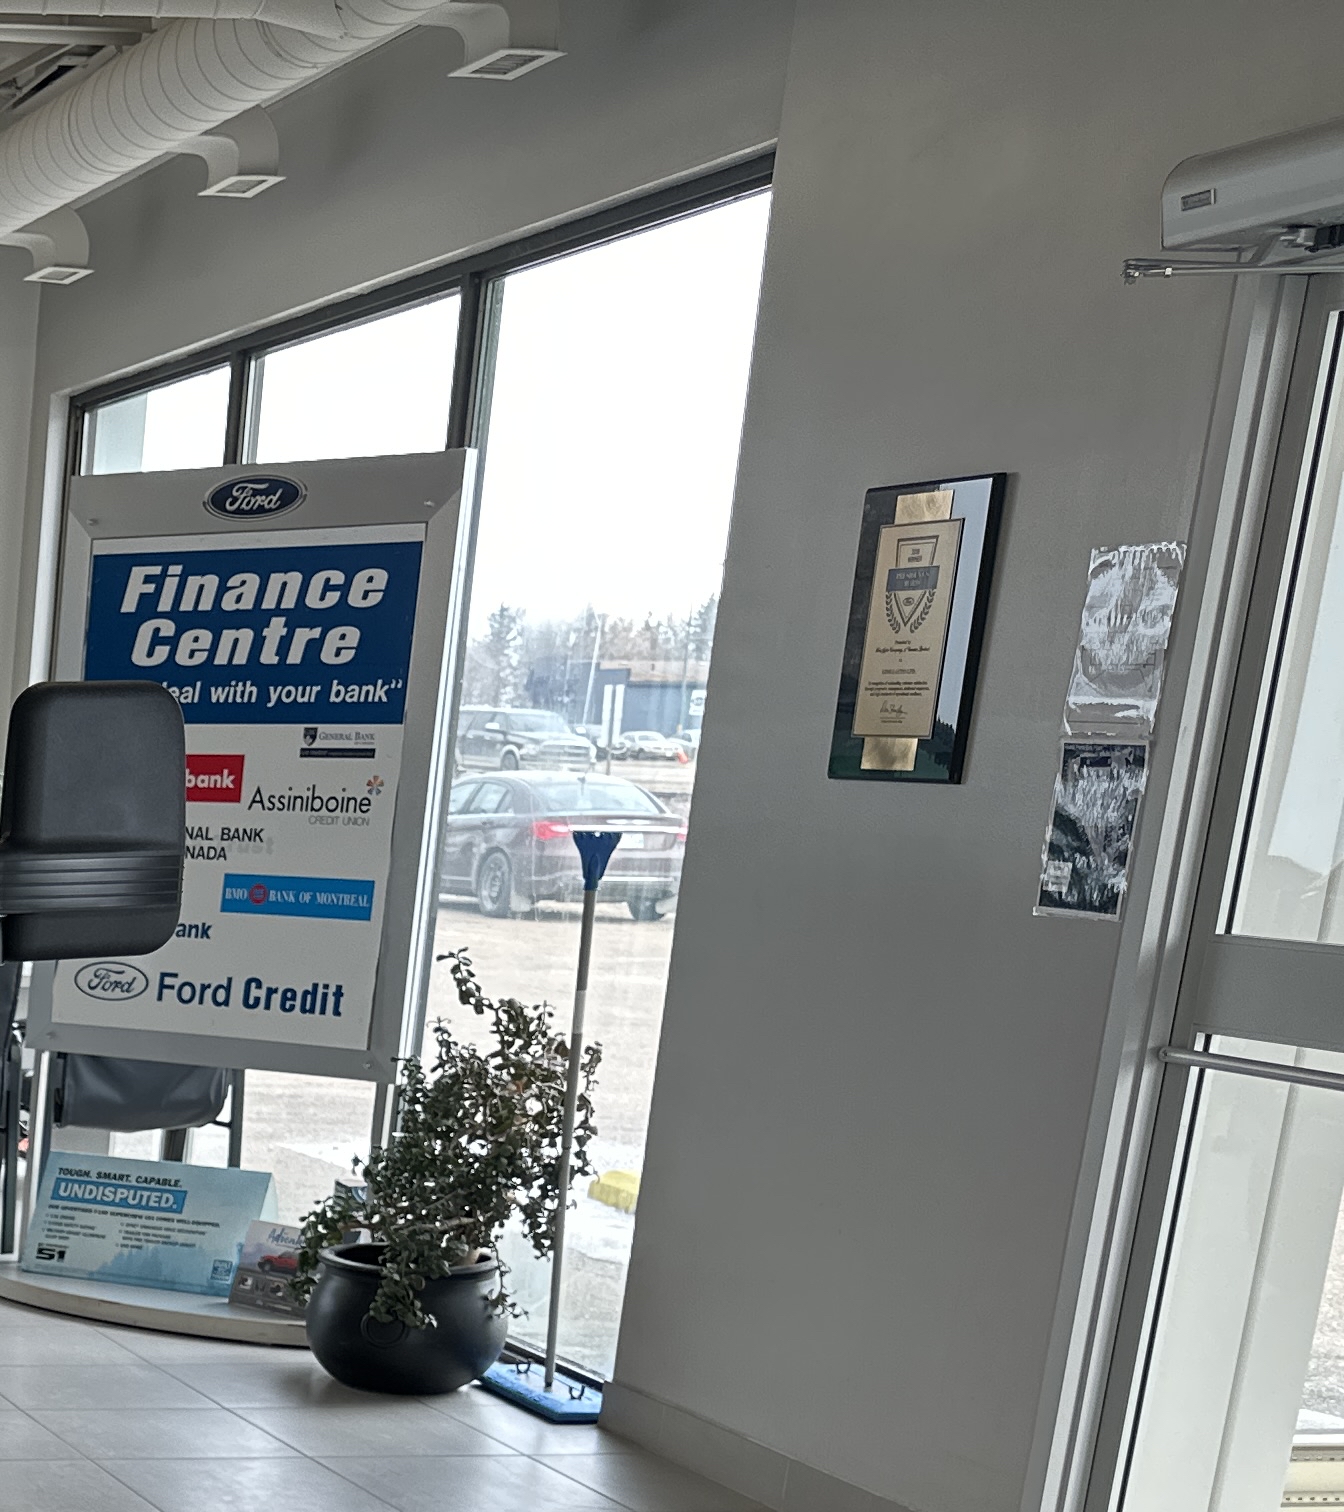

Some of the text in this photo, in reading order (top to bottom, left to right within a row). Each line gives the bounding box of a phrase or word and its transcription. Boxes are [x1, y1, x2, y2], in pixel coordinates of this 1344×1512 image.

[224, 481, 283, 512] Ford
[119, 564, 389, 614] Finance
[130, 616, 362, 668] Centre
[210, 680, 258, 704] with
[266, 685, 321, 708] your
[185, 767, 236, 790] bank
[247, 784, 372, 815] Assiniboine
[308, 814, 370, 828] CREDIT UNION
[185, 826, 265, 844] NAL BANK
[185, 845, 228, 862] NADA
[224, 887, 371, 908] BMO BANK OF MONTREAL
[175, 921, 213, 941] ank
[87, 967, 345, 1017] Ford Ford Credit
[95, 1171, 133, 1185] SMART.
[134, 1174, 183, 1189] CAPABLE.
[57, 1180, 178, 1211] UNDISPUTED.
